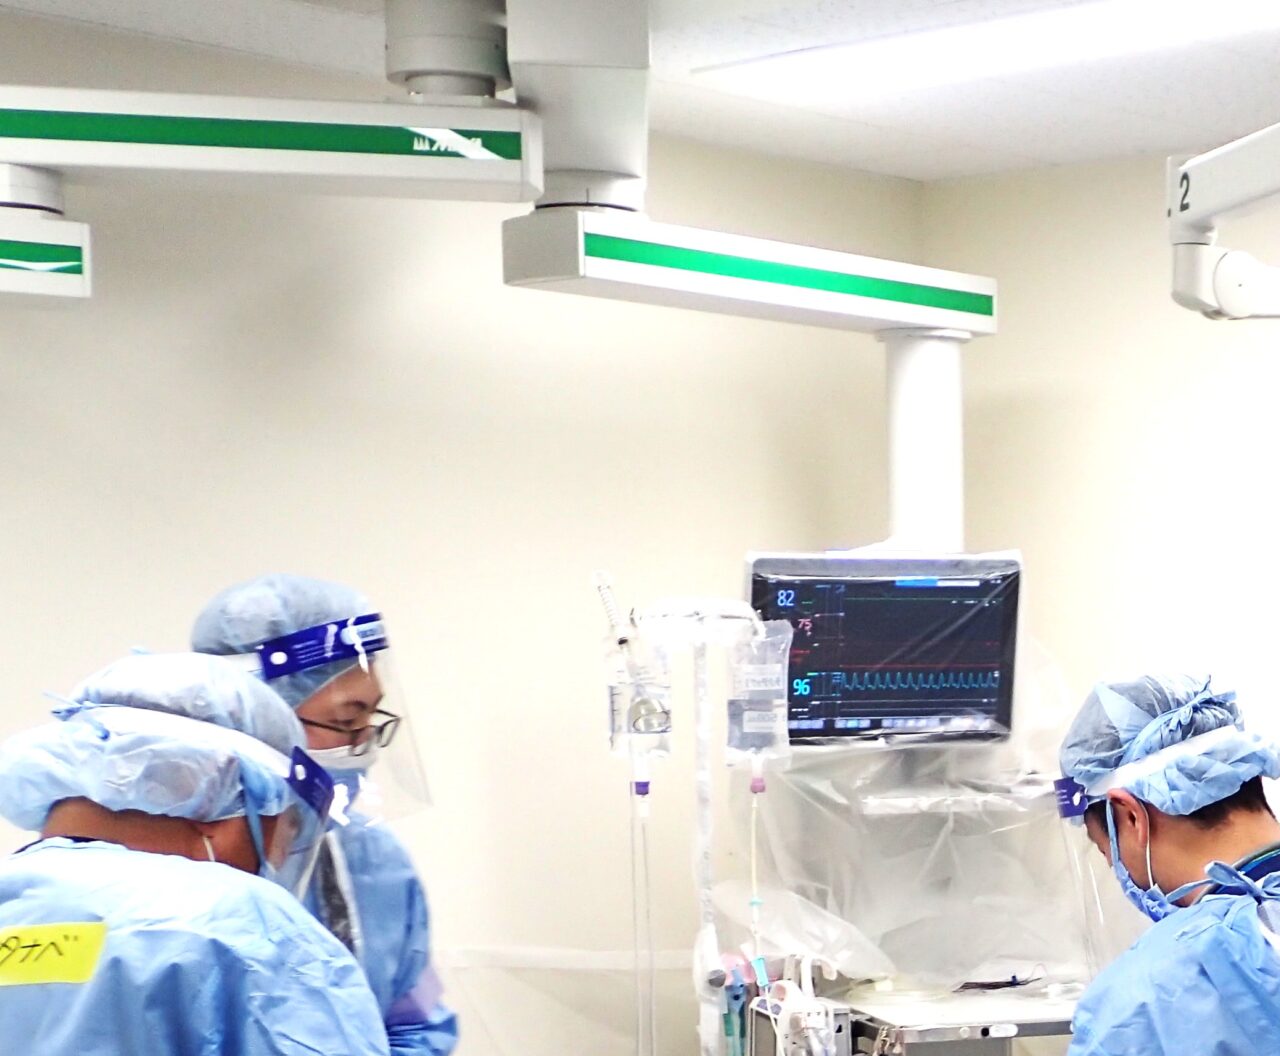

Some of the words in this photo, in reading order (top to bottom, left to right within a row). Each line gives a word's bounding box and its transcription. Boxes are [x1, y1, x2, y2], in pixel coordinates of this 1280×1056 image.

[1179, 172, 1191, 213] 2
[777, 589, 795, 607] 82
[798, 618, 812, 631] 75
[793, 678, 811, 696] 96
